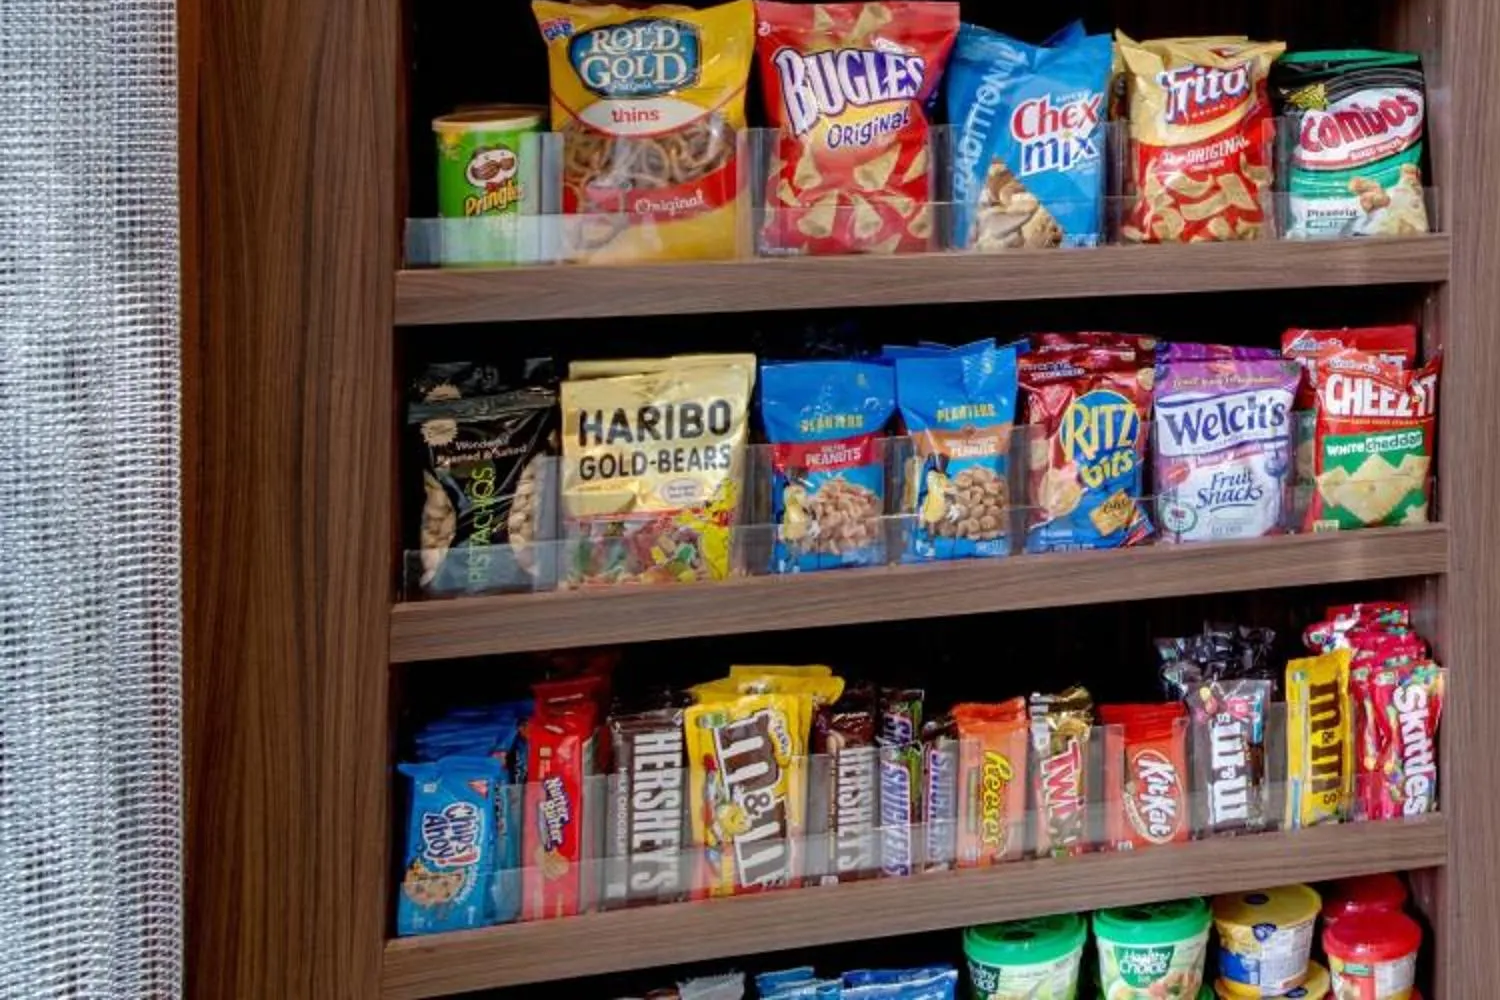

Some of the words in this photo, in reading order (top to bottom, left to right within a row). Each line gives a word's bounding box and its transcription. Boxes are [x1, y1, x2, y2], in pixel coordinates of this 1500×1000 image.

[592, 25, 681, 54] ROLD
[580, 52, 687, 88] GOLD
[1156, 61, 1249, 122] Frito
[775, 49, 925, 137] BUGLES
[1013, 90, 1102, 141] Chex
[611, 108, 662, 124] thins
[1022, 131, 1099, 173] mix
[1186, 136, 1250, 161] ORIGINAL
[635, 188, 705, 217] Original
[578, 399, 732, 448] HARIBO
[1064, 402, 1137, 463] RITZ
[1162, 396, 1286, 447] Welch's
[579, 444, 732, 481] GOLD-BEARS
[805, 447, 862, 466] PEANUTS
[1082, 449, 1136, 490] bits
[1197, 484, 1264, 511] Snacks
[1211, 469, 1254, 491] Fruit
[467, 467, 496, 583] PISTACHIOS
[1392, 683, 1438, 818] Skittles
[443, 803, 479, 854] Chips
[631, 732, 683, 892] HERSHEY'S
[880, 761, 910, 877] SNICKERS
